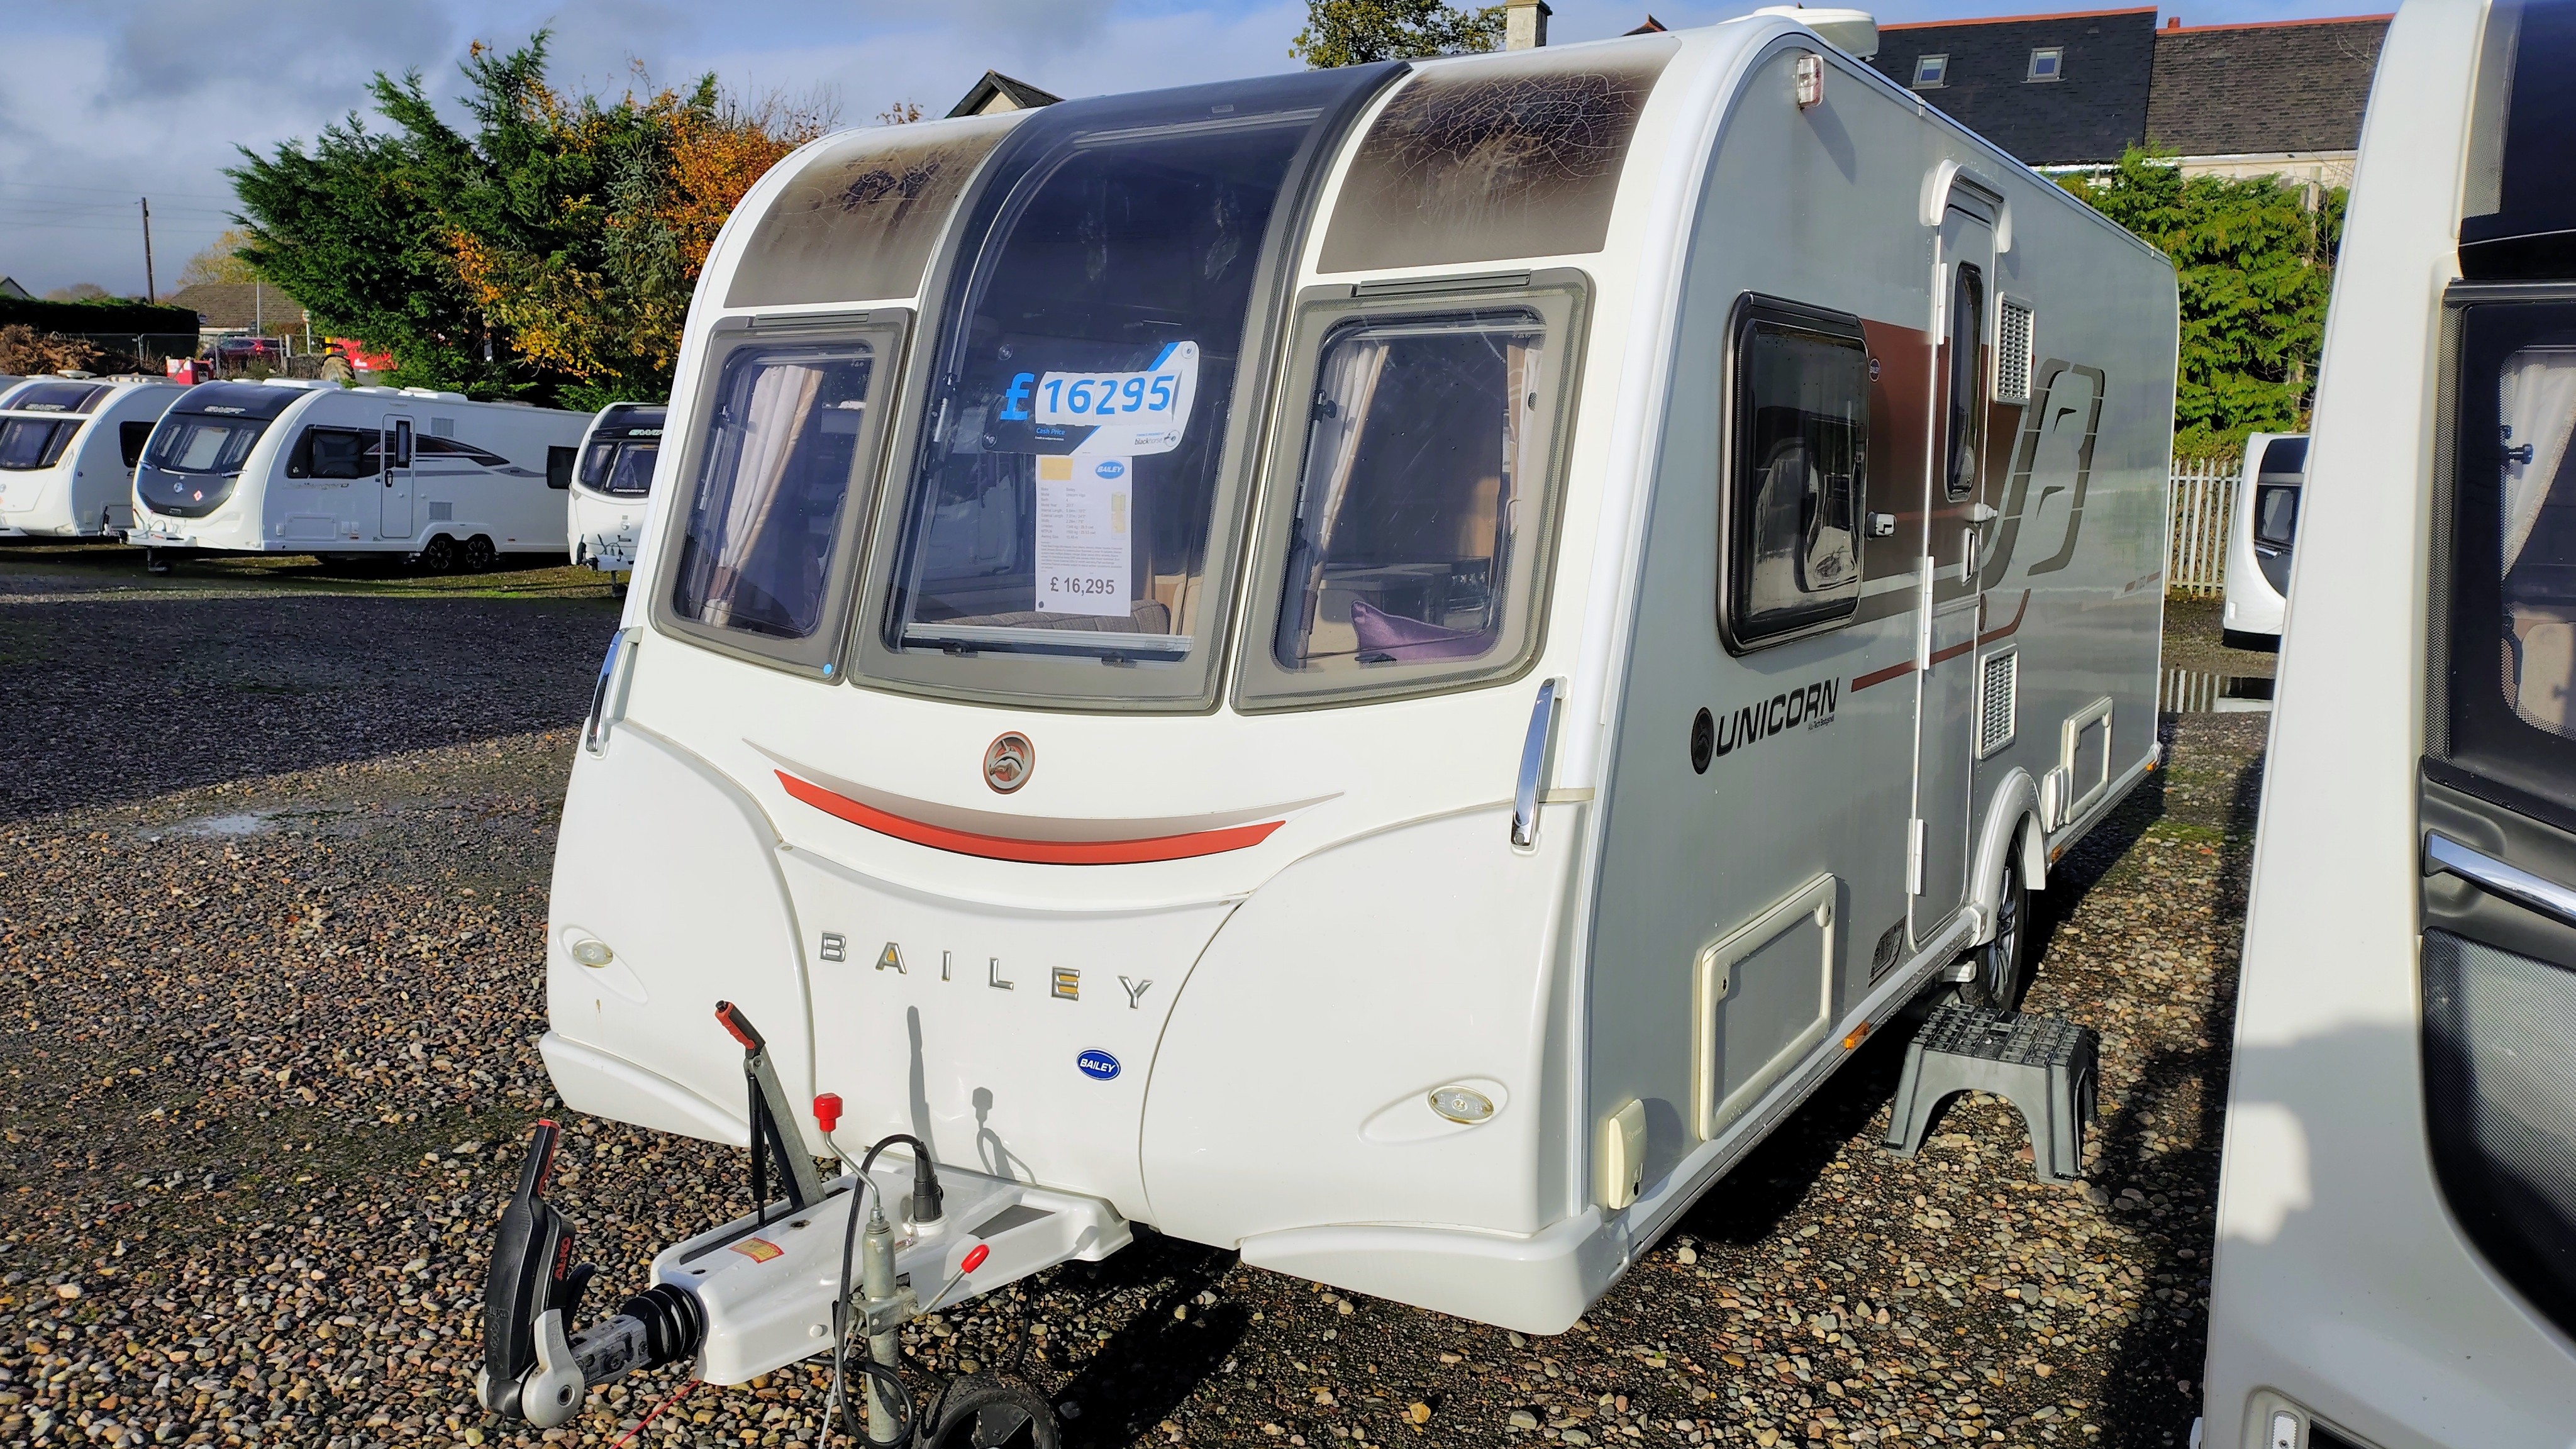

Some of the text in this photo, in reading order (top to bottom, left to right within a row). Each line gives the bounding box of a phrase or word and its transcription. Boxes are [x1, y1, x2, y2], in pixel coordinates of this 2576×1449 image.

[1050, 577, 1115, 596] £ 16,295
[1717, 677, 1840, 757] UNICORN
[819, 931, 1153, 1010] BAILEY
[1080, 1058, 1115, 1074] BAILEY
[554, 1236, 571, 1281] AL-KO
